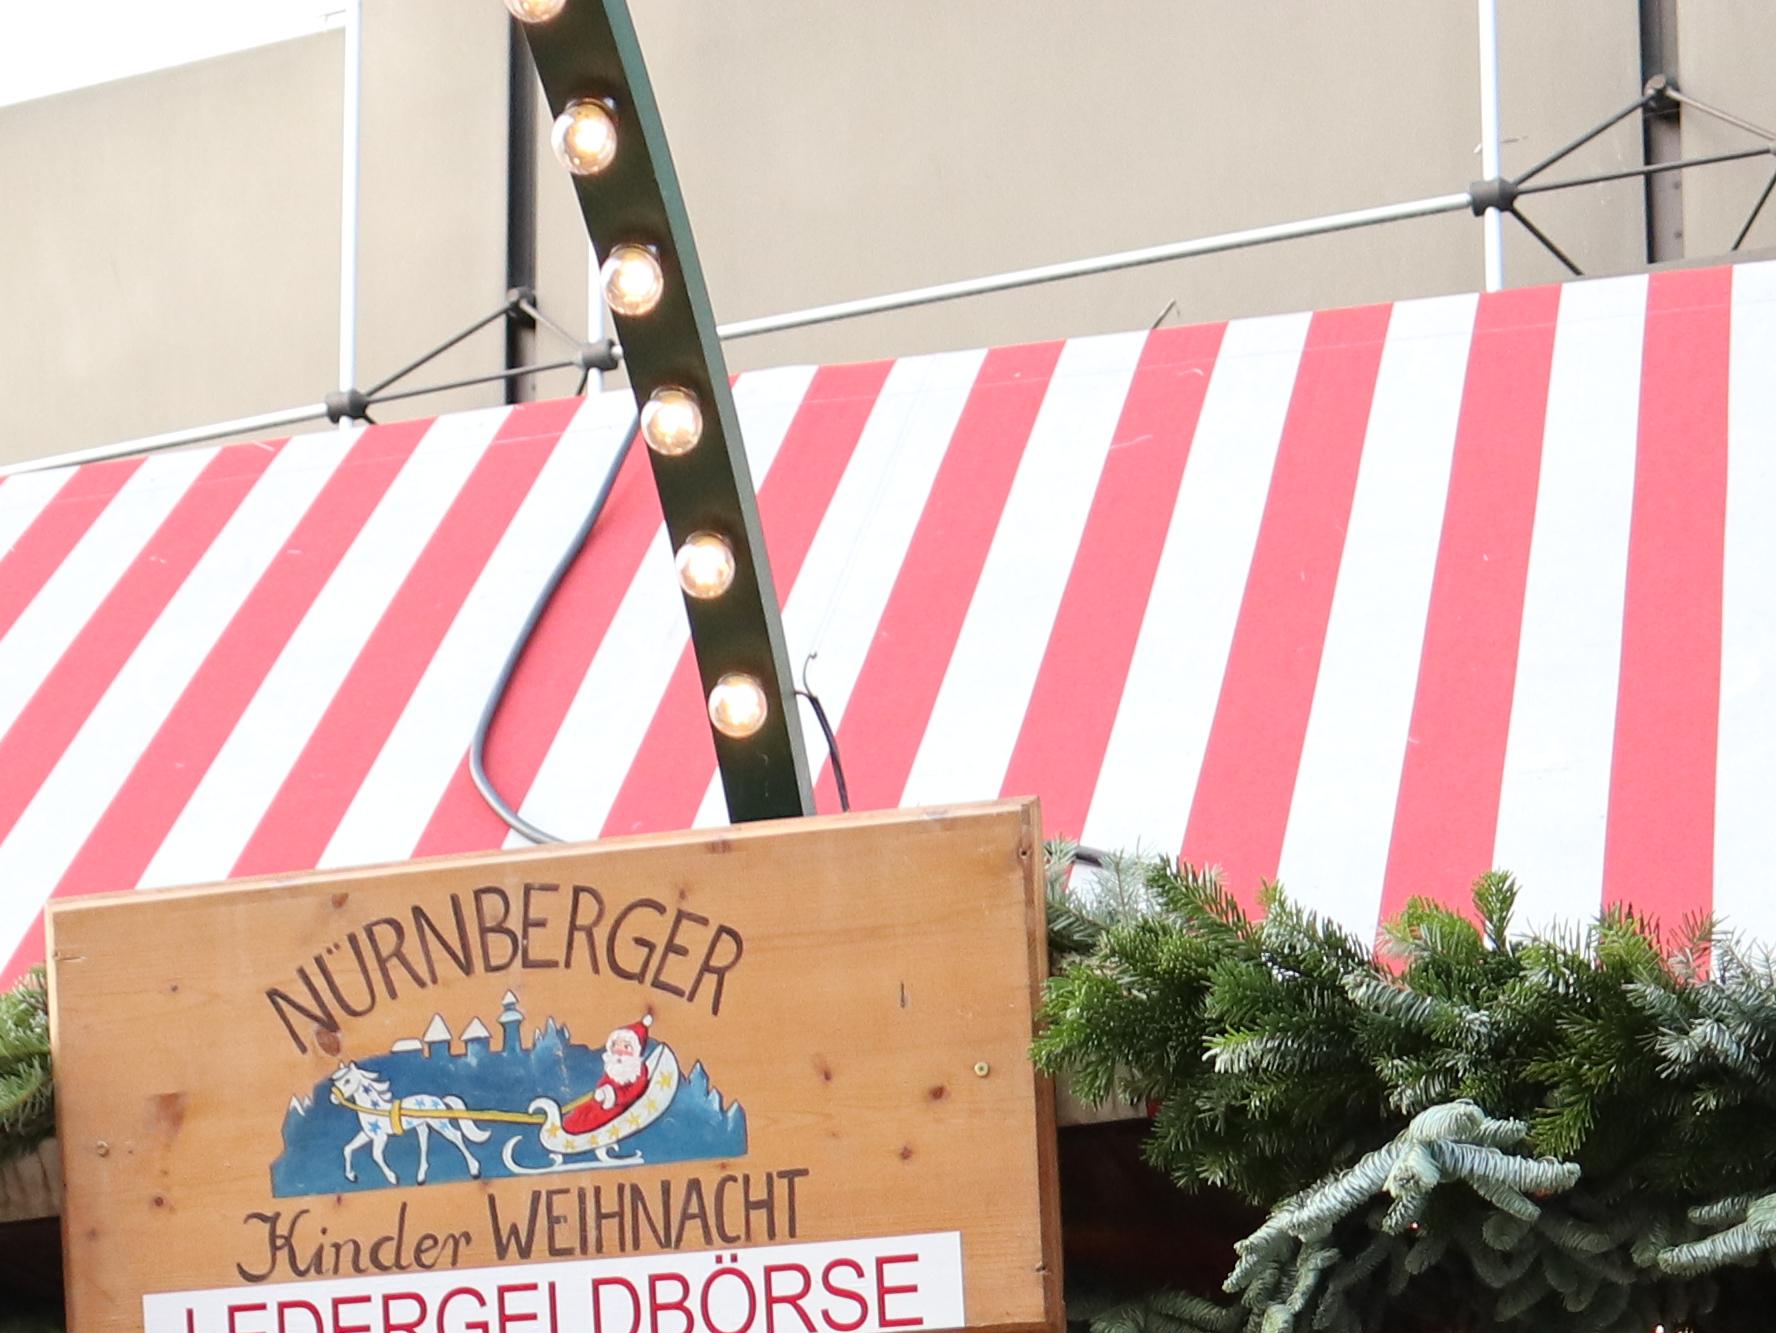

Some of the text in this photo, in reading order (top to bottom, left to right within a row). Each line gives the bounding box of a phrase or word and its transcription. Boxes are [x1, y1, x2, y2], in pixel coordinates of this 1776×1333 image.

[264, 882, 744, 1055] NÜRNBERGER
[236, 1167, 809, 1284] Kinder WEIHNACHT
